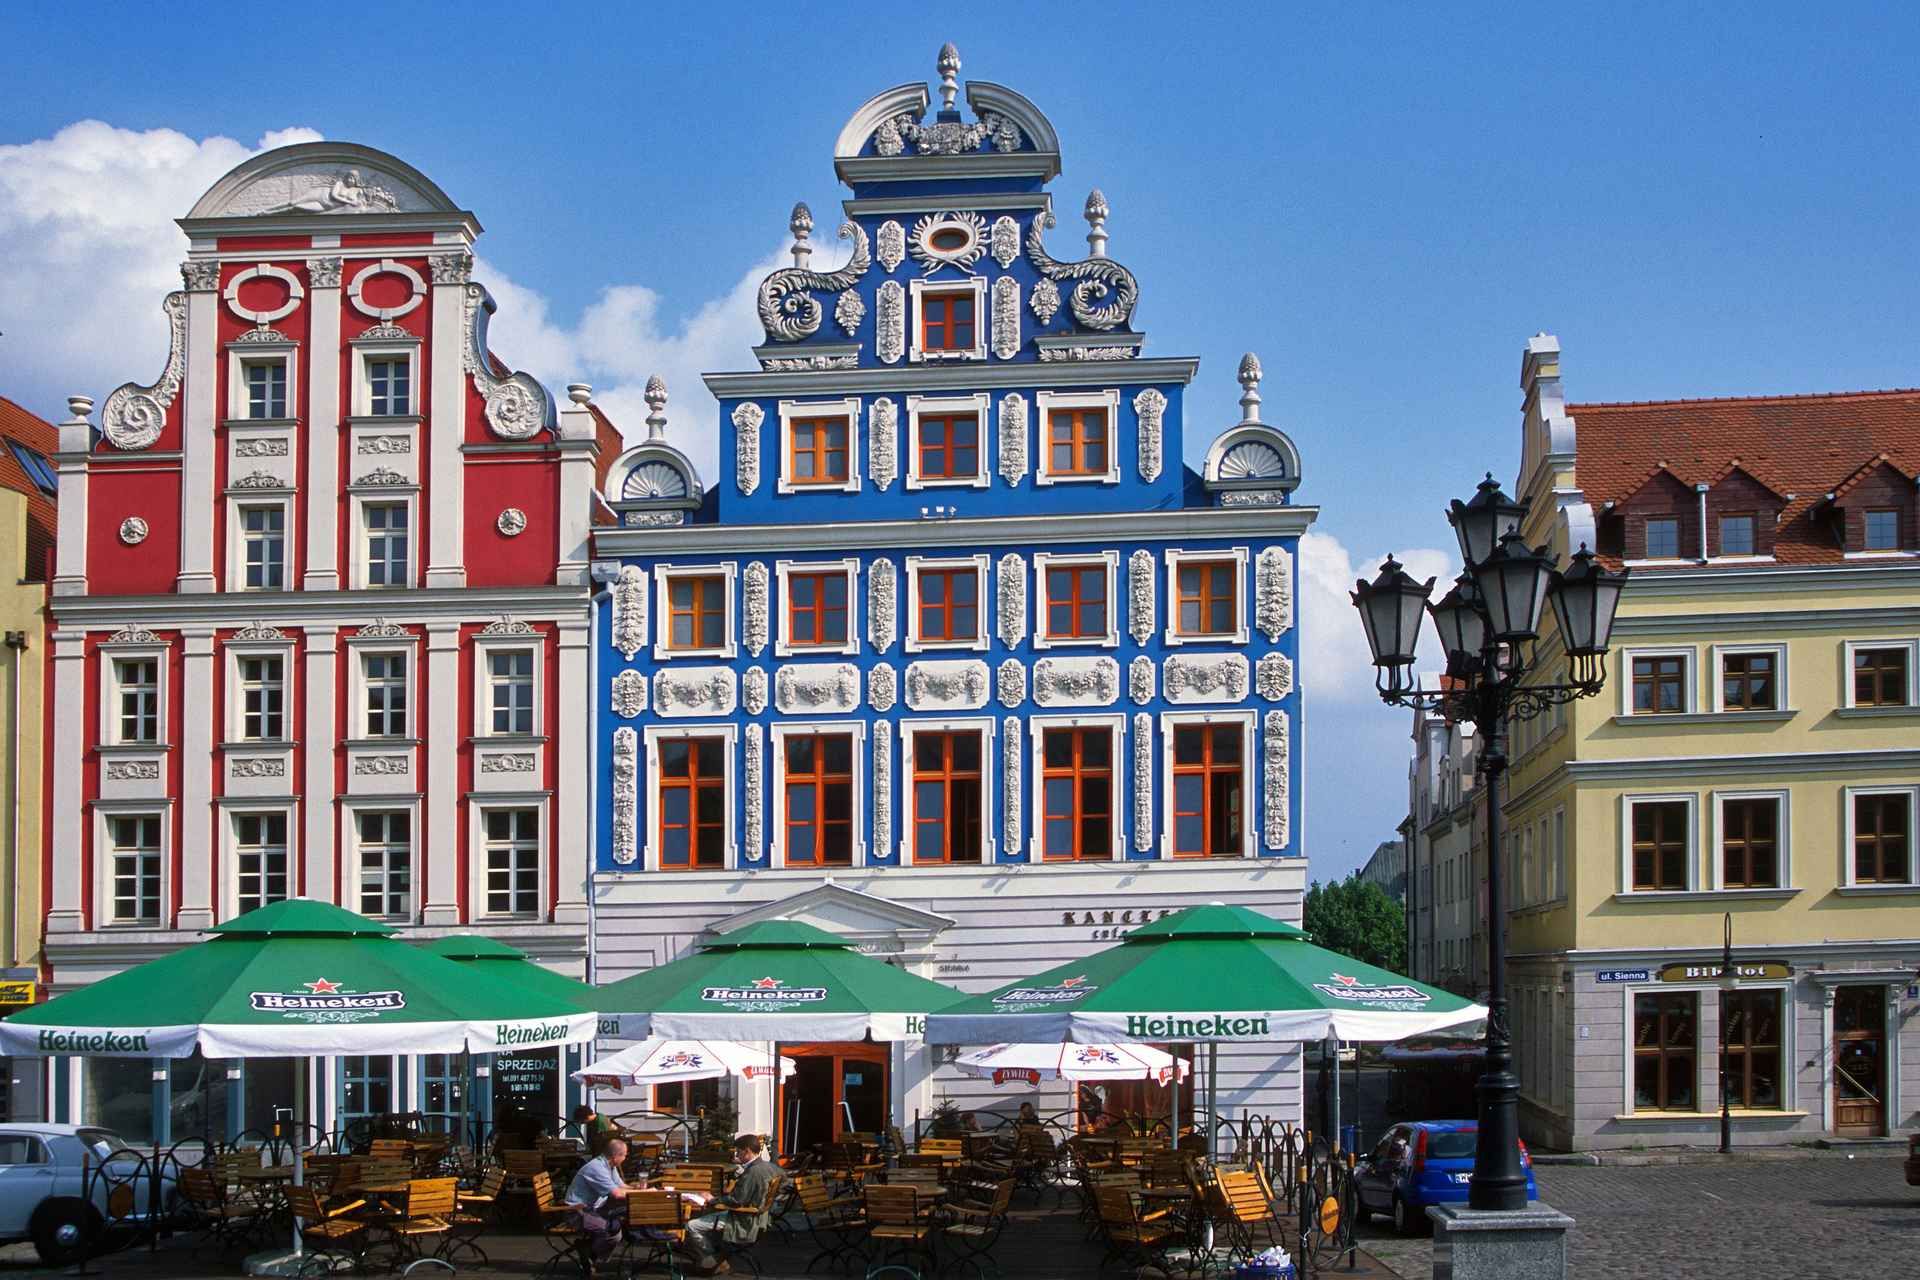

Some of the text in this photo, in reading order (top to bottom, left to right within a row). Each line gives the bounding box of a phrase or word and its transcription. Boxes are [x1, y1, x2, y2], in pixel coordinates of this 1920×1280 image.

[1063, 909, 1184, 924] KANCL
[1601, 972, 1646, 981] ul. Sienna
[1686, 965, 1765, 977] Biblot
[263, 995, 394, 1008] Heineken
[713, 990, 816, 999] Heineken
[1126, 1015, 1269, 1037] Heineken
[496, 1022, 568, 1045] Heineken
[39, 1030, 149, 1052] Heineken
